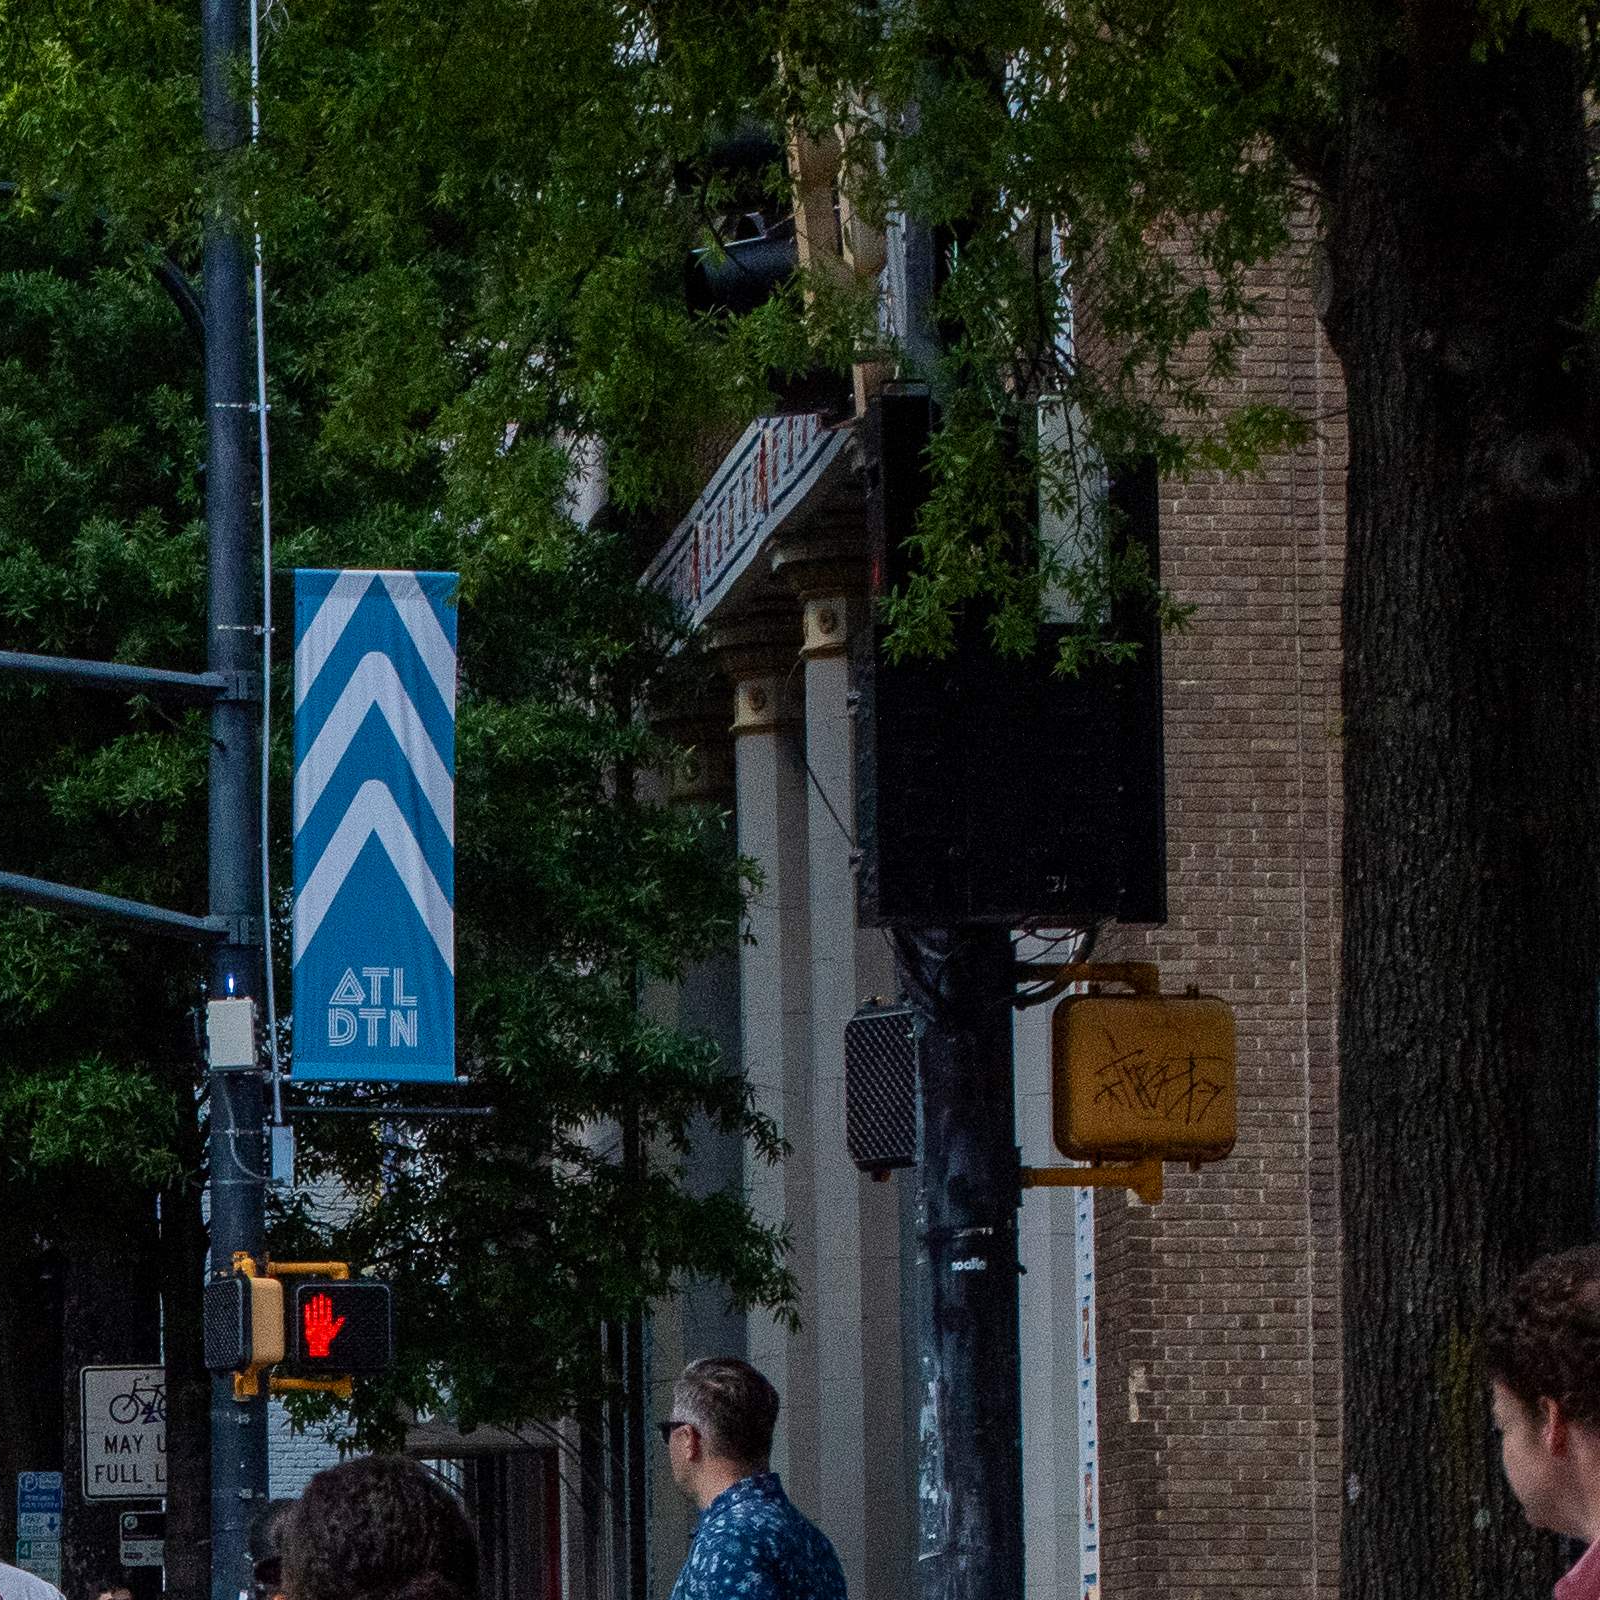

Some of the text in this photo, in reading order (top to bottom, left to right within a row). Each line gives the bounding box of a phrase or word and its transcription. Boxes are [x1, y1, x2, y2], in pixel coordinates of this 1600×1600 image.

[328, 966, 418, 1006] ATL
[328, 1008, 418, 1048] DTN
[104, 1434, 143, 1454] MAY
[95, 1464, 143, 1483] FULL
